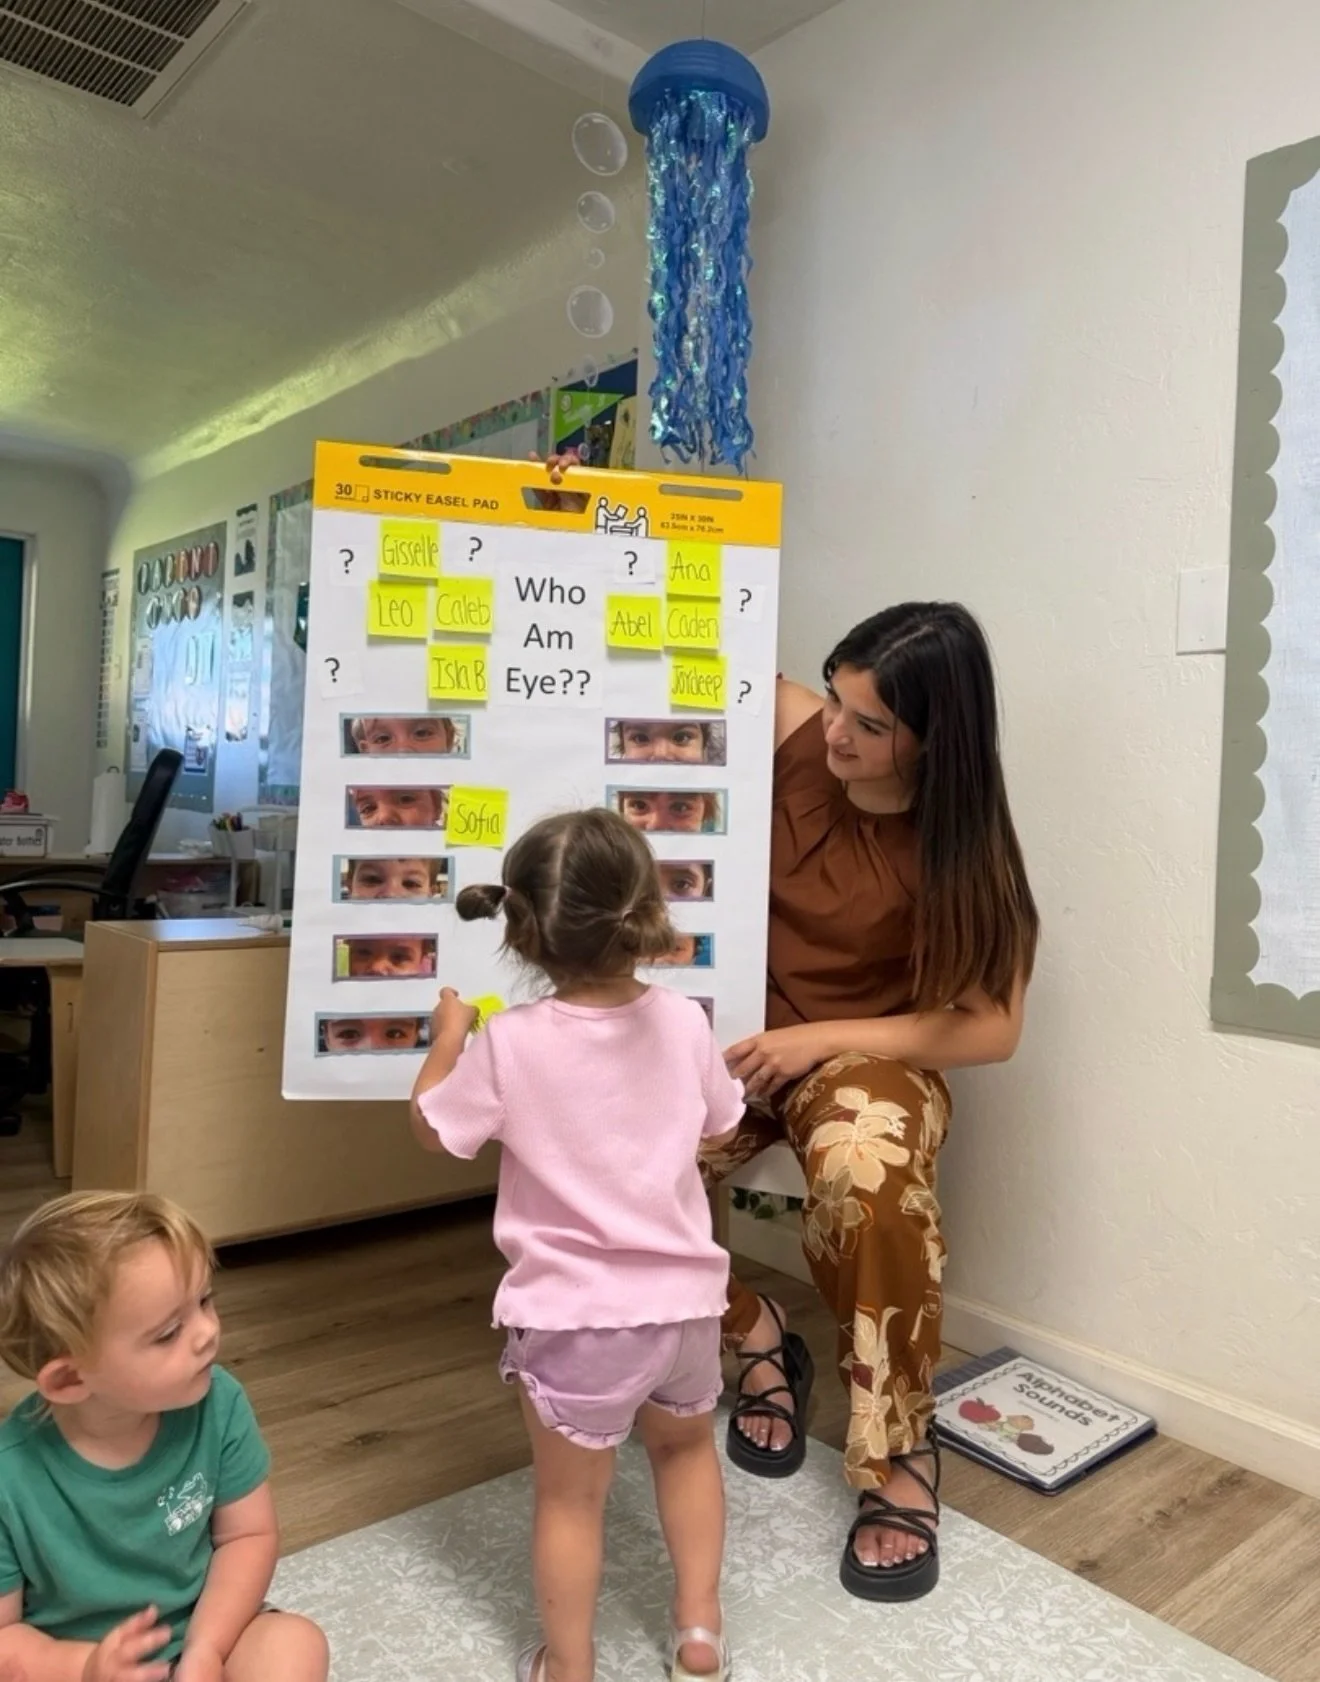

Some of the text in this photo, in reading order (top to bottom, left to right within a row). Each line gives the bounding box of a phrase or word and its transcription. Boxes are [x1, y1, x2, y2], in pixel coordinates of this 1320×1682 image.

[335, 483, 499, 510] 30 STICKY EASEL PAD
[339, 548, 355, 574] ?
[382, 534, 439, 567] Gisselle
[468, 536, 483, 562] ?
[624, 551, 638, 575] ?
[669, 552, 711, 581] Ana
[515, 576, 586, 605] Who
[739, 588, 752, 613] ?
[377, 593, 413, 627] Leo
[436, 593, 491, 626] Caleb
[667, 607, 719, 639] Caden
[523, 623, 573, 650] Am
[609, 611, 653, 638] Abel
[324, 657, 340, 683] ?
[475, 659, 487, 692] B
[506, 667, 591, 700] Eye??
[737, 680, 752, 704] ?
[454, 803, 501, 841] Sofia
[1012, 1382, 1094, 1428] Sounds
[1016, 1370, 1122, 1424] Alphabet
